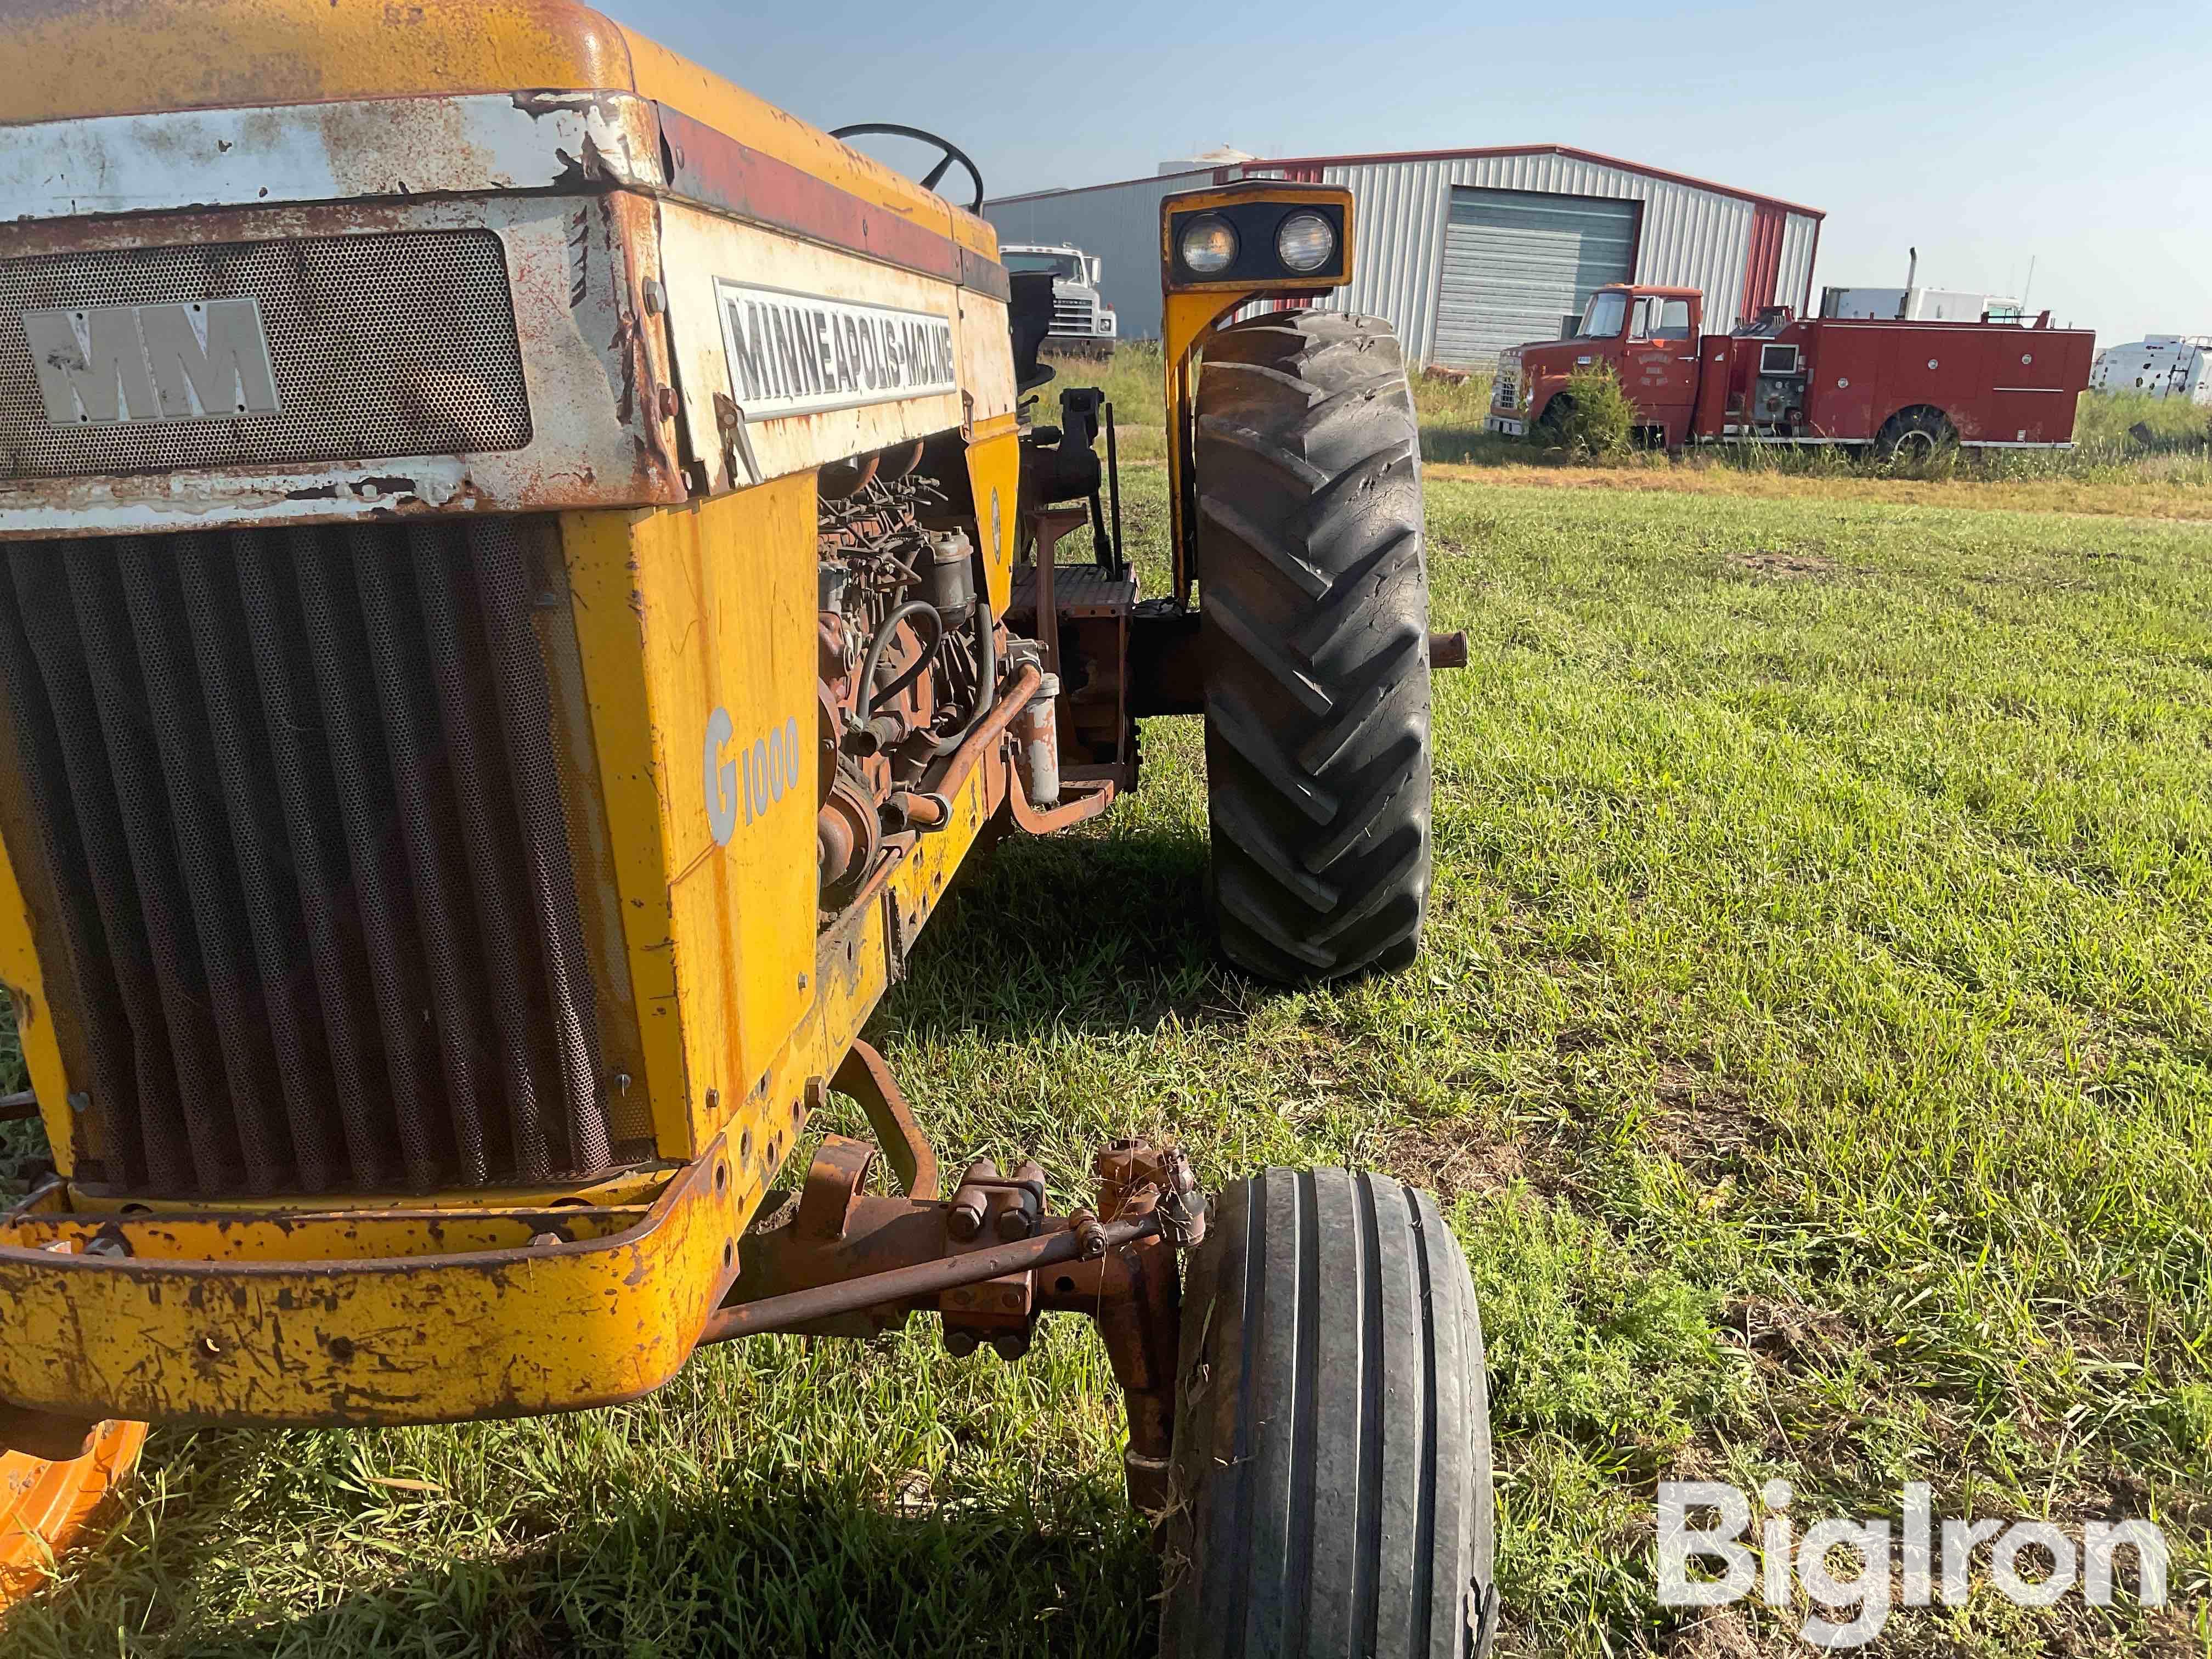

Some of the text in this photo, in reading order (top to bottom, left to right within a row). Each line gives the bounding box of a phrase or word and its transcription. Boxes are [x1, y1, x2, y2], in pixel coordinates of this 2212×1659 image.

[24, 297, 283, 428] MM
[724, 298, 955, 401] MINNEAPOLIS-MOLINE
[703, 706, 799, 847] G1000
